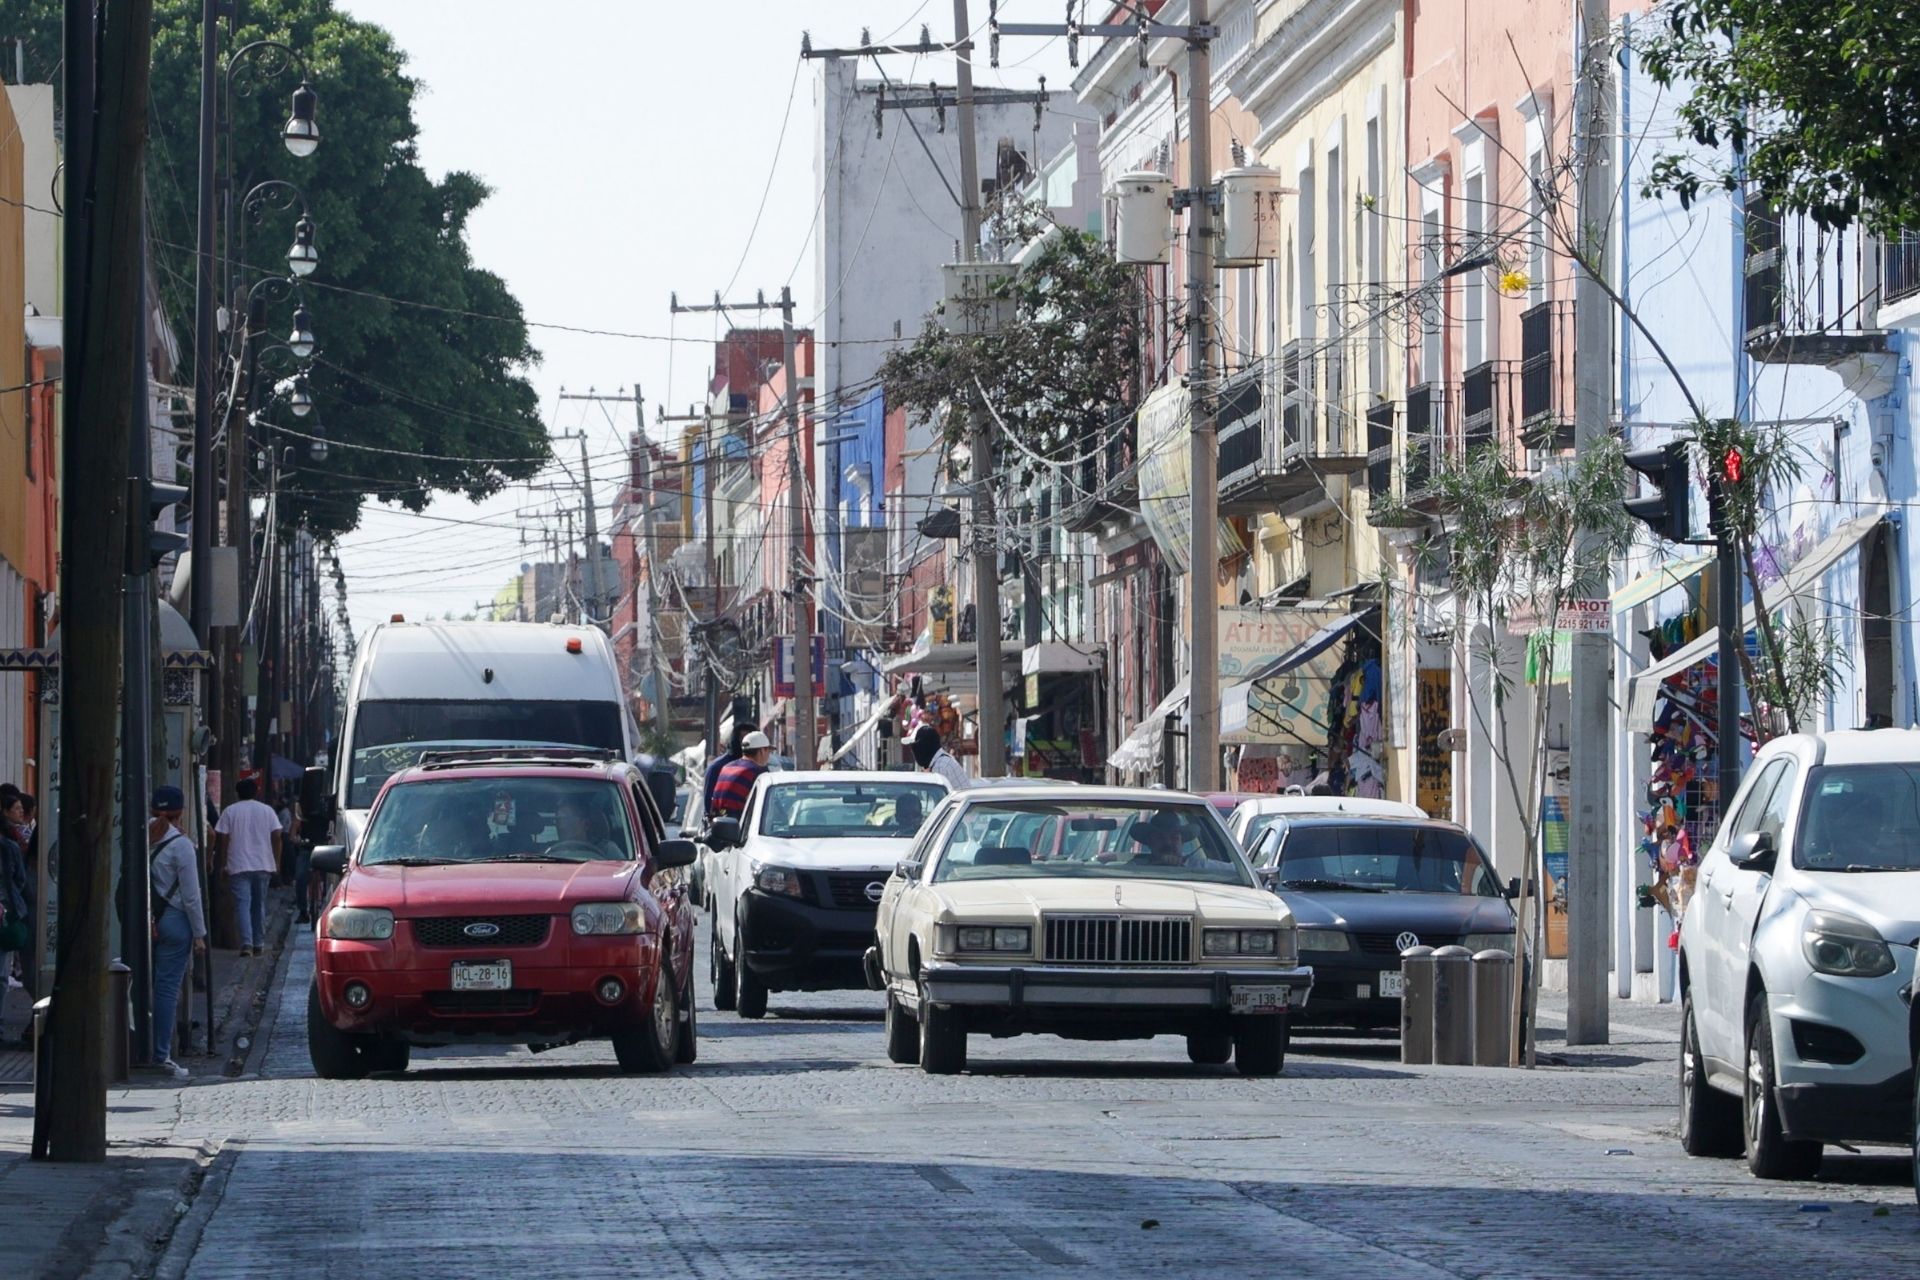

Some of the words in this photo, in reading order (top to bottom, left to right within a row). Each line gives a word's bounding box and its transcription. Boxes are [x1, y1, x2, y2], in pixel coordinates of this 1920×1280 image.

[1558, 601, 1610, 612] TAROT
[1558, 619, 1576, 629] 2215
[1579, 619, 1592, 629] 921
[1596, 620, 1609, 630] 147
[456, 968, 507, 980] HCL-28-16
[1231, 992, 1288, 1006] UHF-138-A
